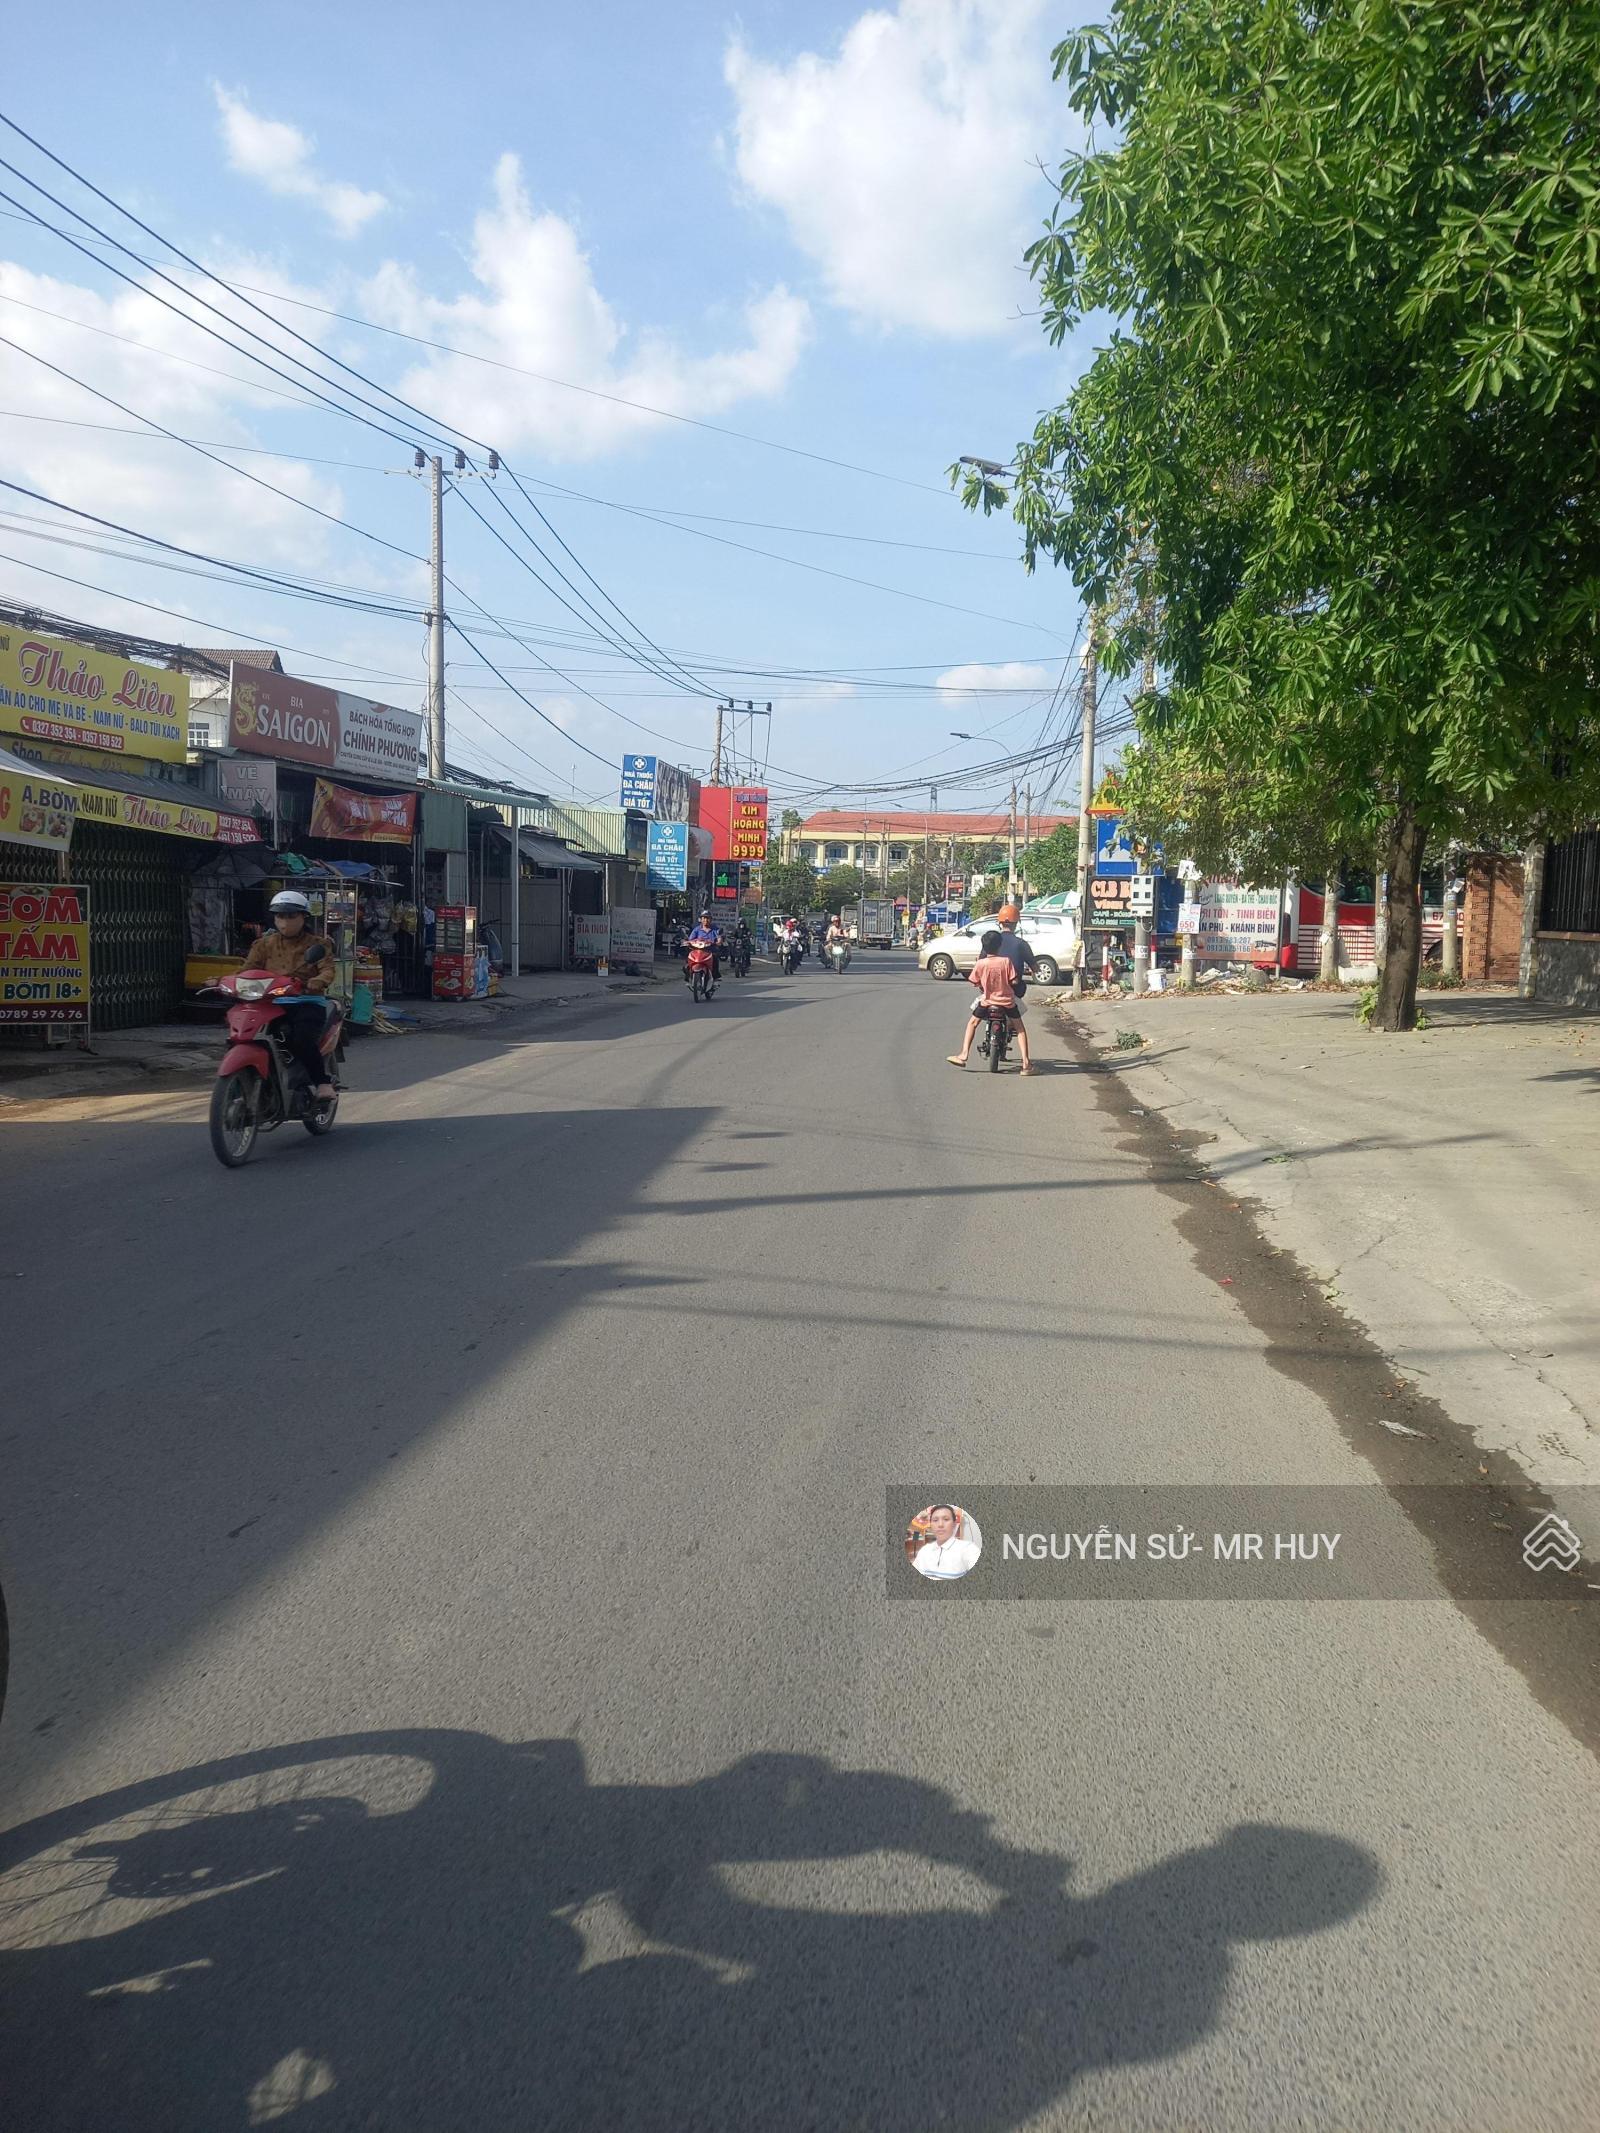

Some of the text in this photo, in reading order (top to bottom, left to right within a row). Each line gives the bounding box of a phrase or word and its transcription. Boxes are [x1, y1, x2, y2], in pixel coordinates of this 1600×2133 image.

[19, 641, 176, 717] Thảo Liên
[291, 696, 304, 709] BIA
[28, 694, 46, 713] CHO
[48, 699, 61, 720] MẸ
[63, 701, 74, 719] VÀ
[76, 704, 86, 721] BÉ
[93, 709, 111, 726] NAM
[113, 712, 125, 729] NỮ
[130, 717, 148, 734] BALO
[32, 720, 49, 735] 0327
[50, 723, 63, 738] 352
[64, 726, 77, 740] 354
[82, 730, 98, 745] 0357
[99, 734, 110, 747] 150
[111, 736, 123, 749] 522
[256, 704, 331, 749] SAIGON
[343, 728, 417, 762] CHÍNH PHƯƠNG
[83, 793, 103, 815] NAM
[741, 806, 758, 816] KIM
[737, 833, 760, 843] MINH
[733, 845, 764, 857] 9999
[32, 1010, 47, 1019] 59
[50, 1010, 65, 1019] 76
[68, 1010, 82, 1019] 76
